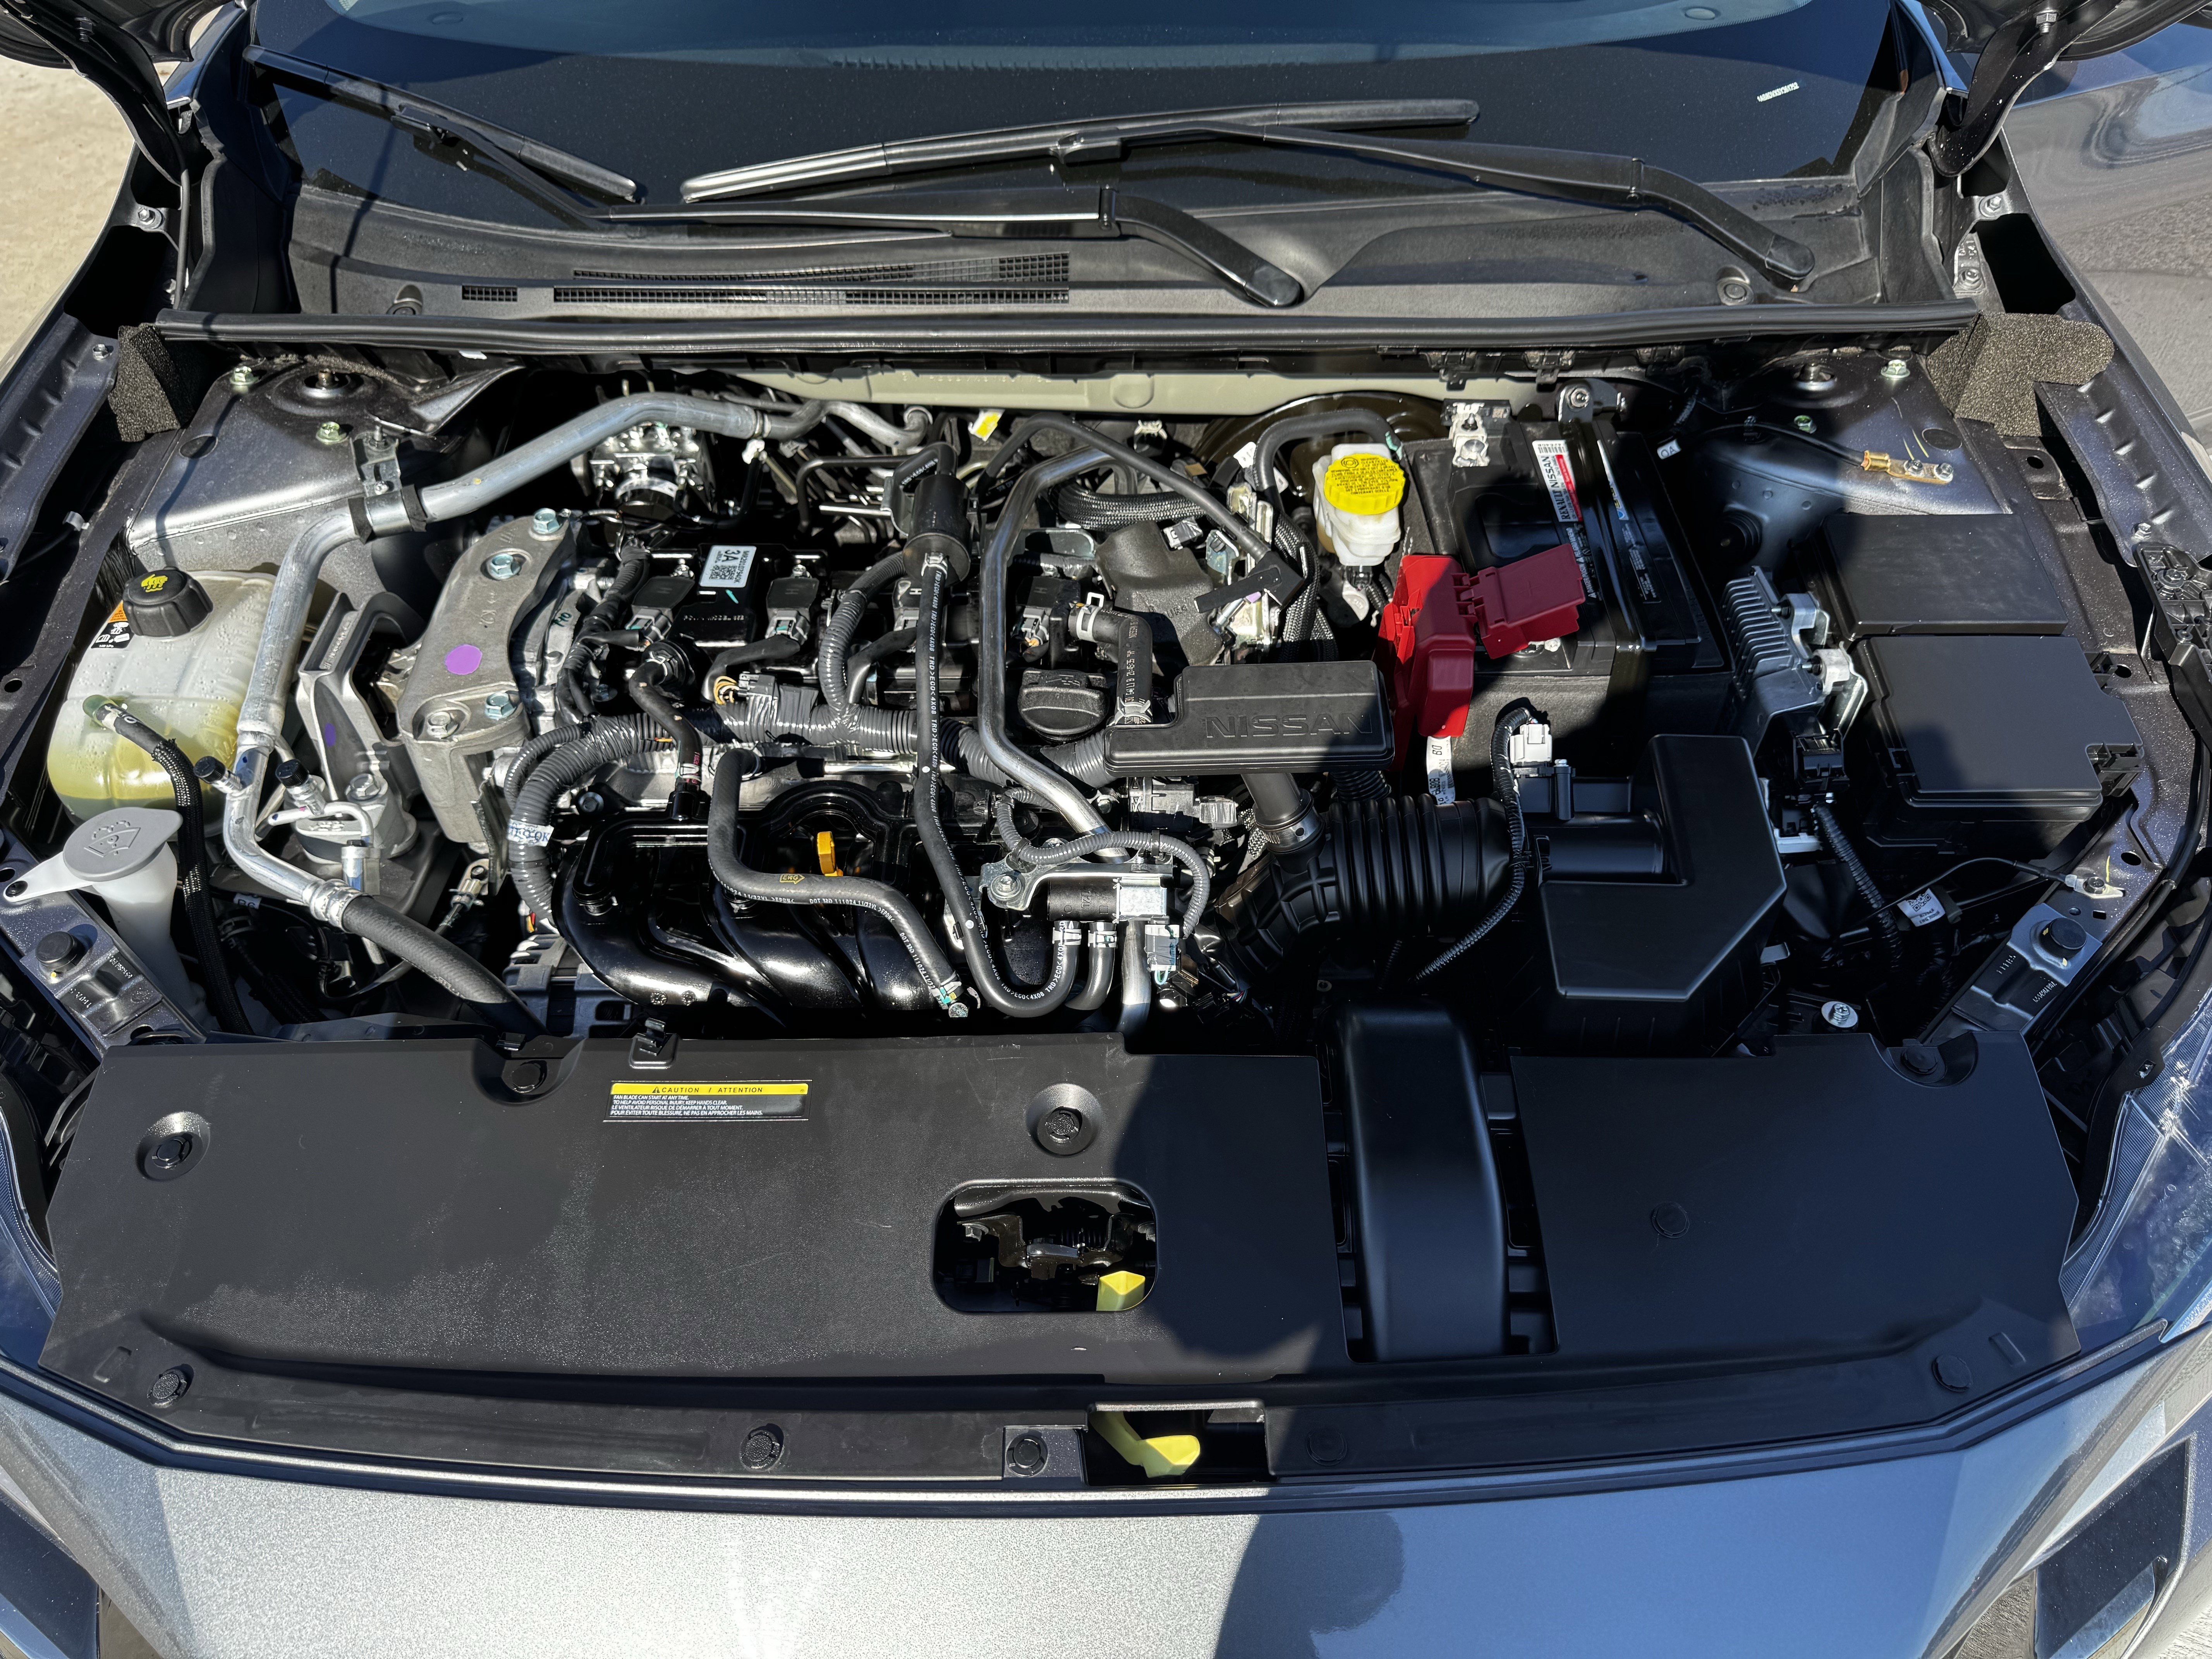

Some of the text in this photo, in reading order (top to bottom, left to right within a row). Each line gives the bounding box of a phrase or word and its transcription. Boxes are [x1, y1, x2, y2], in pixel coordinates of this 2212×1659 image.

[1541, 456, 1559, 488] NISSAN
[1553, 490, 1570, 520] RENAULT
[722, 550, 741, 562] 3A
[1206, 713, 1372, 738] NISSAN
